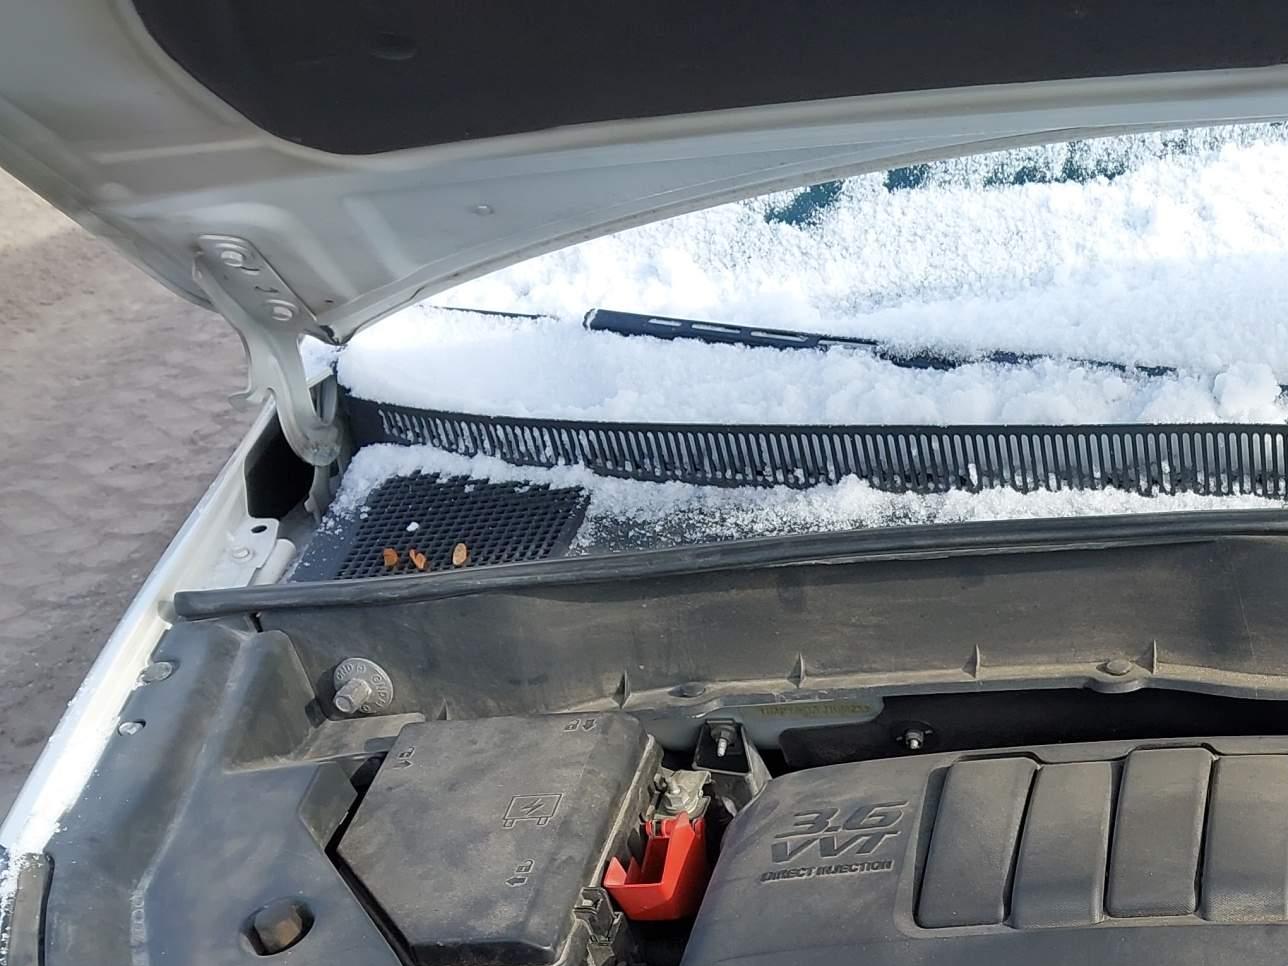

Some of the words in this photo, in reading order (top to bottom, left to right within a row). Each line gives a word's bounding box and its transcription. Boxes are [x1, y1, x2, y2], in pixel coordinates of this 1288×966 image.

[773, 799, 910, 839] 3.6
[771, 831, 902, 865] VVT
[760, 866, 814, 883] DIRECT
[815, 859, 895, 876] INJECTION
